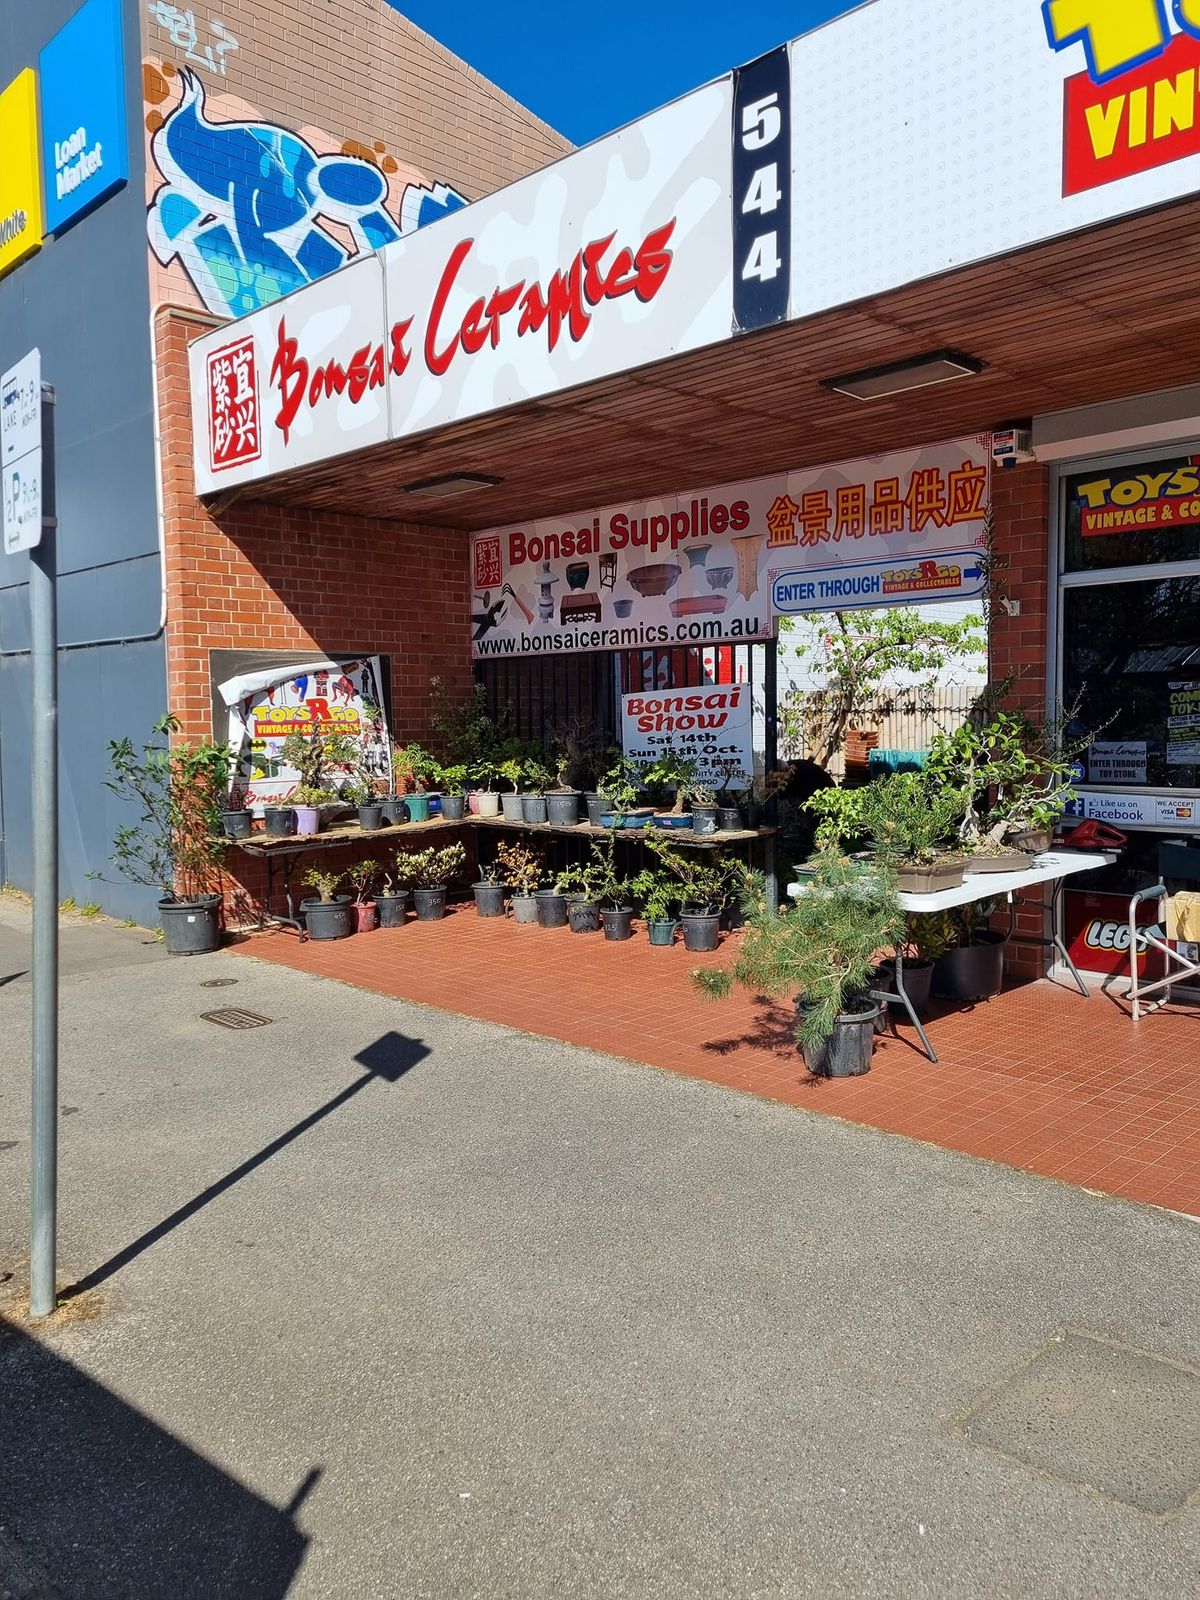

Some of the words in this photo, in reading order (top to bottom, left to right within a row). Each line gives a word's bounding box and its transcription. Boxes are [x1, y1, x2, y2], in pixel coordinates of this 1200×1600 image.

[1085, 65, 1200, 160] VIN
[54, 126, 87, 171] Loan
[56, 141, 104, 201] Market
[742, 92, 782, 283] 544
[269, 314, 413, 448] Bonsai
[424, 216, 677, 376] Ceramics
[3, 409, 18, 433] LANE
[766, 460, 987, 548] 盆景用品供应
[1086, 506, 1157, 530] VINTAGE
[1161, 504, 1174, 521] &
[509, 518, 600, 565] Bonsai
[609, 498, 751, 552] Supplies
[776, 584, 816, 602] ENTER
[818, 576, 880, 598] THROUGH
[884, 582, 909, 592] VINTAGE
[916, 576, 960, 588] COLLECTABLES
[477, 616, 760, 655] www.bonsaiceramics.com.au
[627, 687, 741, 716] Bonsai
[1169, 703, 1194, 715] TOY
[256, 724, 292, 734] VINTAGE
[637, 712, 728, 733] Show
[647, 735, 673, 745] Sat
[680, 732, 717, 743] 14th
[628, 748, 656, 758] Sun
[703, 745, 744, 754] Oct.
[1090, 759, 1111, 768] ENTER
[1112, 759, 1146, 768] THROUGH
[1099, 770, 1112, 778] TOY
[1114, 770, 1136, 778] STORE
[724, 812, 737, 820] 250
[1089, 809, 1143, 821] Facebook
[1100, 800, 1116, 808] Like
